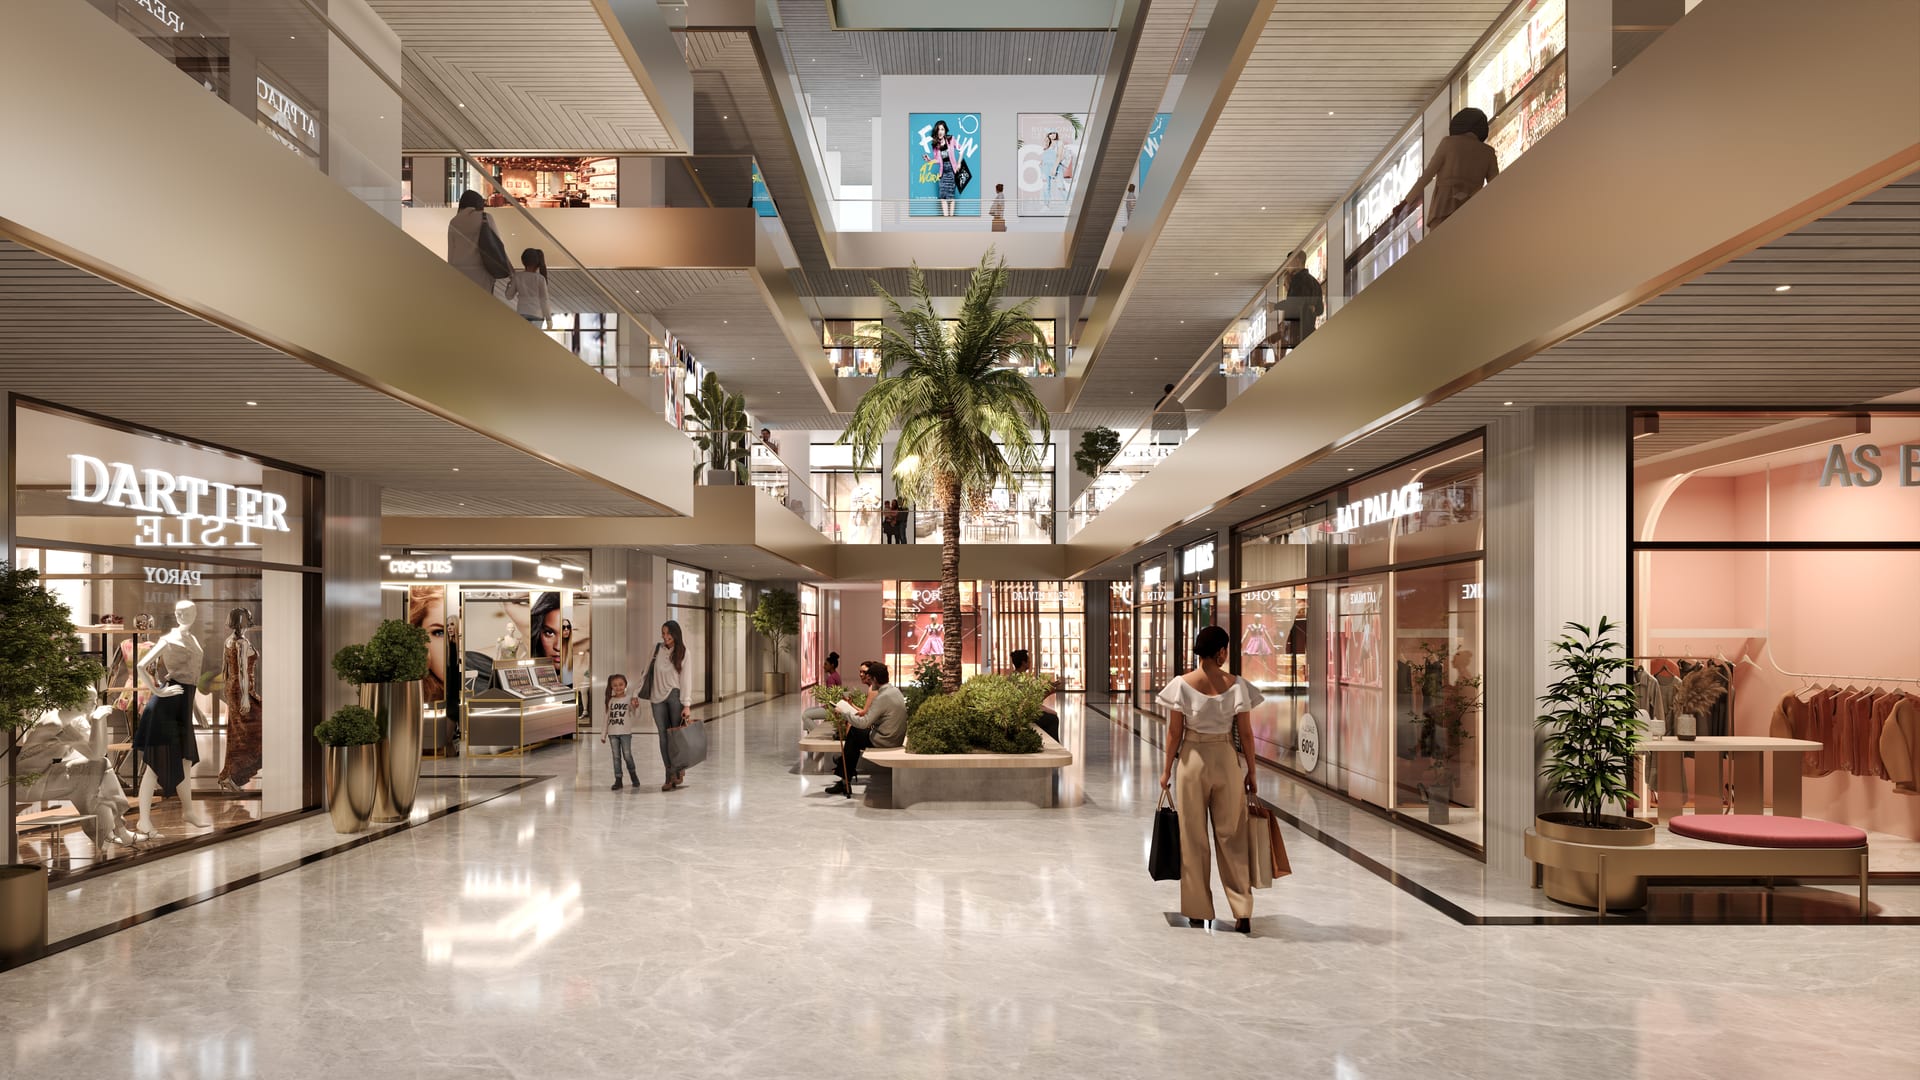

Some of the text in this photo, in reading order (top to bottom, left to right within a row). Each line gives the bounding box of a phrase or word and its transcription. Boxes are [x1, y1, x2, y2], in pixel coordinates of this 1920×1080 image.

[1819, 443, 1882, 487] AS
[67, 454, 290, 532] DARTIER
[1363, 482, 1423, 526] PALACE
[389, 560, 452, 573] COSMETICS
[610, 703, 628, 711] LOVE
[608, 718, 625, 726] YORK
[1301, 738, 1316, 756] 60%
